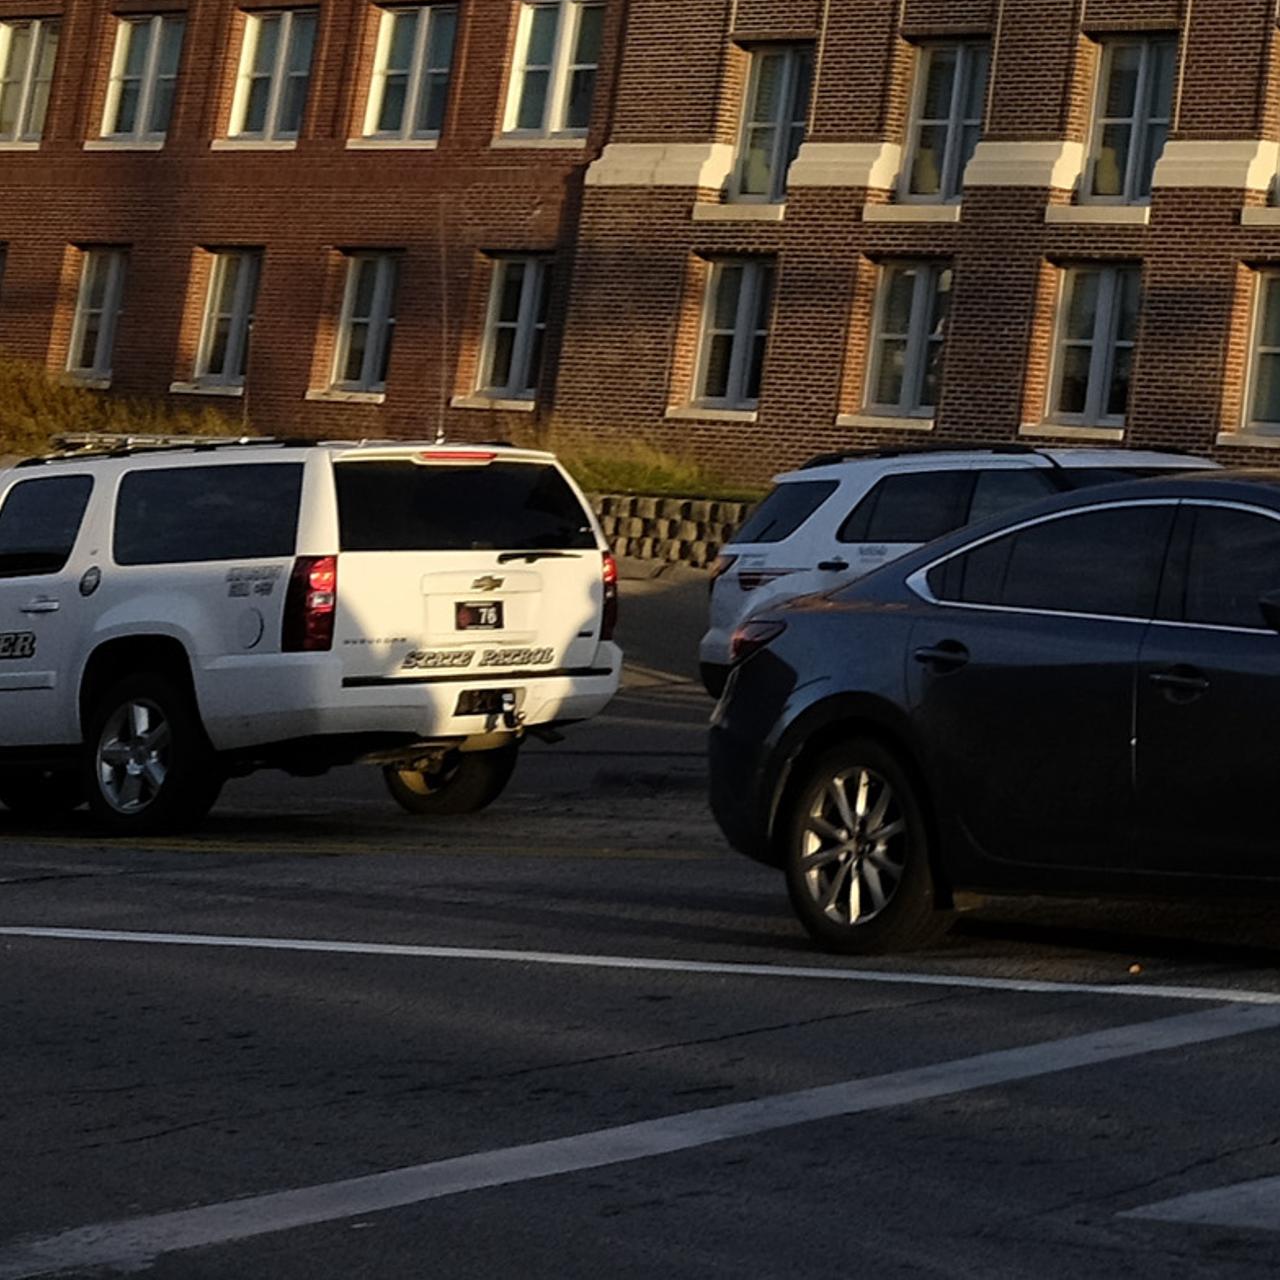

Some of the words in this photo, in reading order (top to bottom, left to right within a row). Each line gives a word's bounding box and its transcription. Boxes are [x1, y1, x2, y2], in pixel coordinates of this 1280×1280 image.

[478, 606, 498, 624] 76
[401, 650, 475, 669] STATE
[478, 647, 554, 667] PATROL
